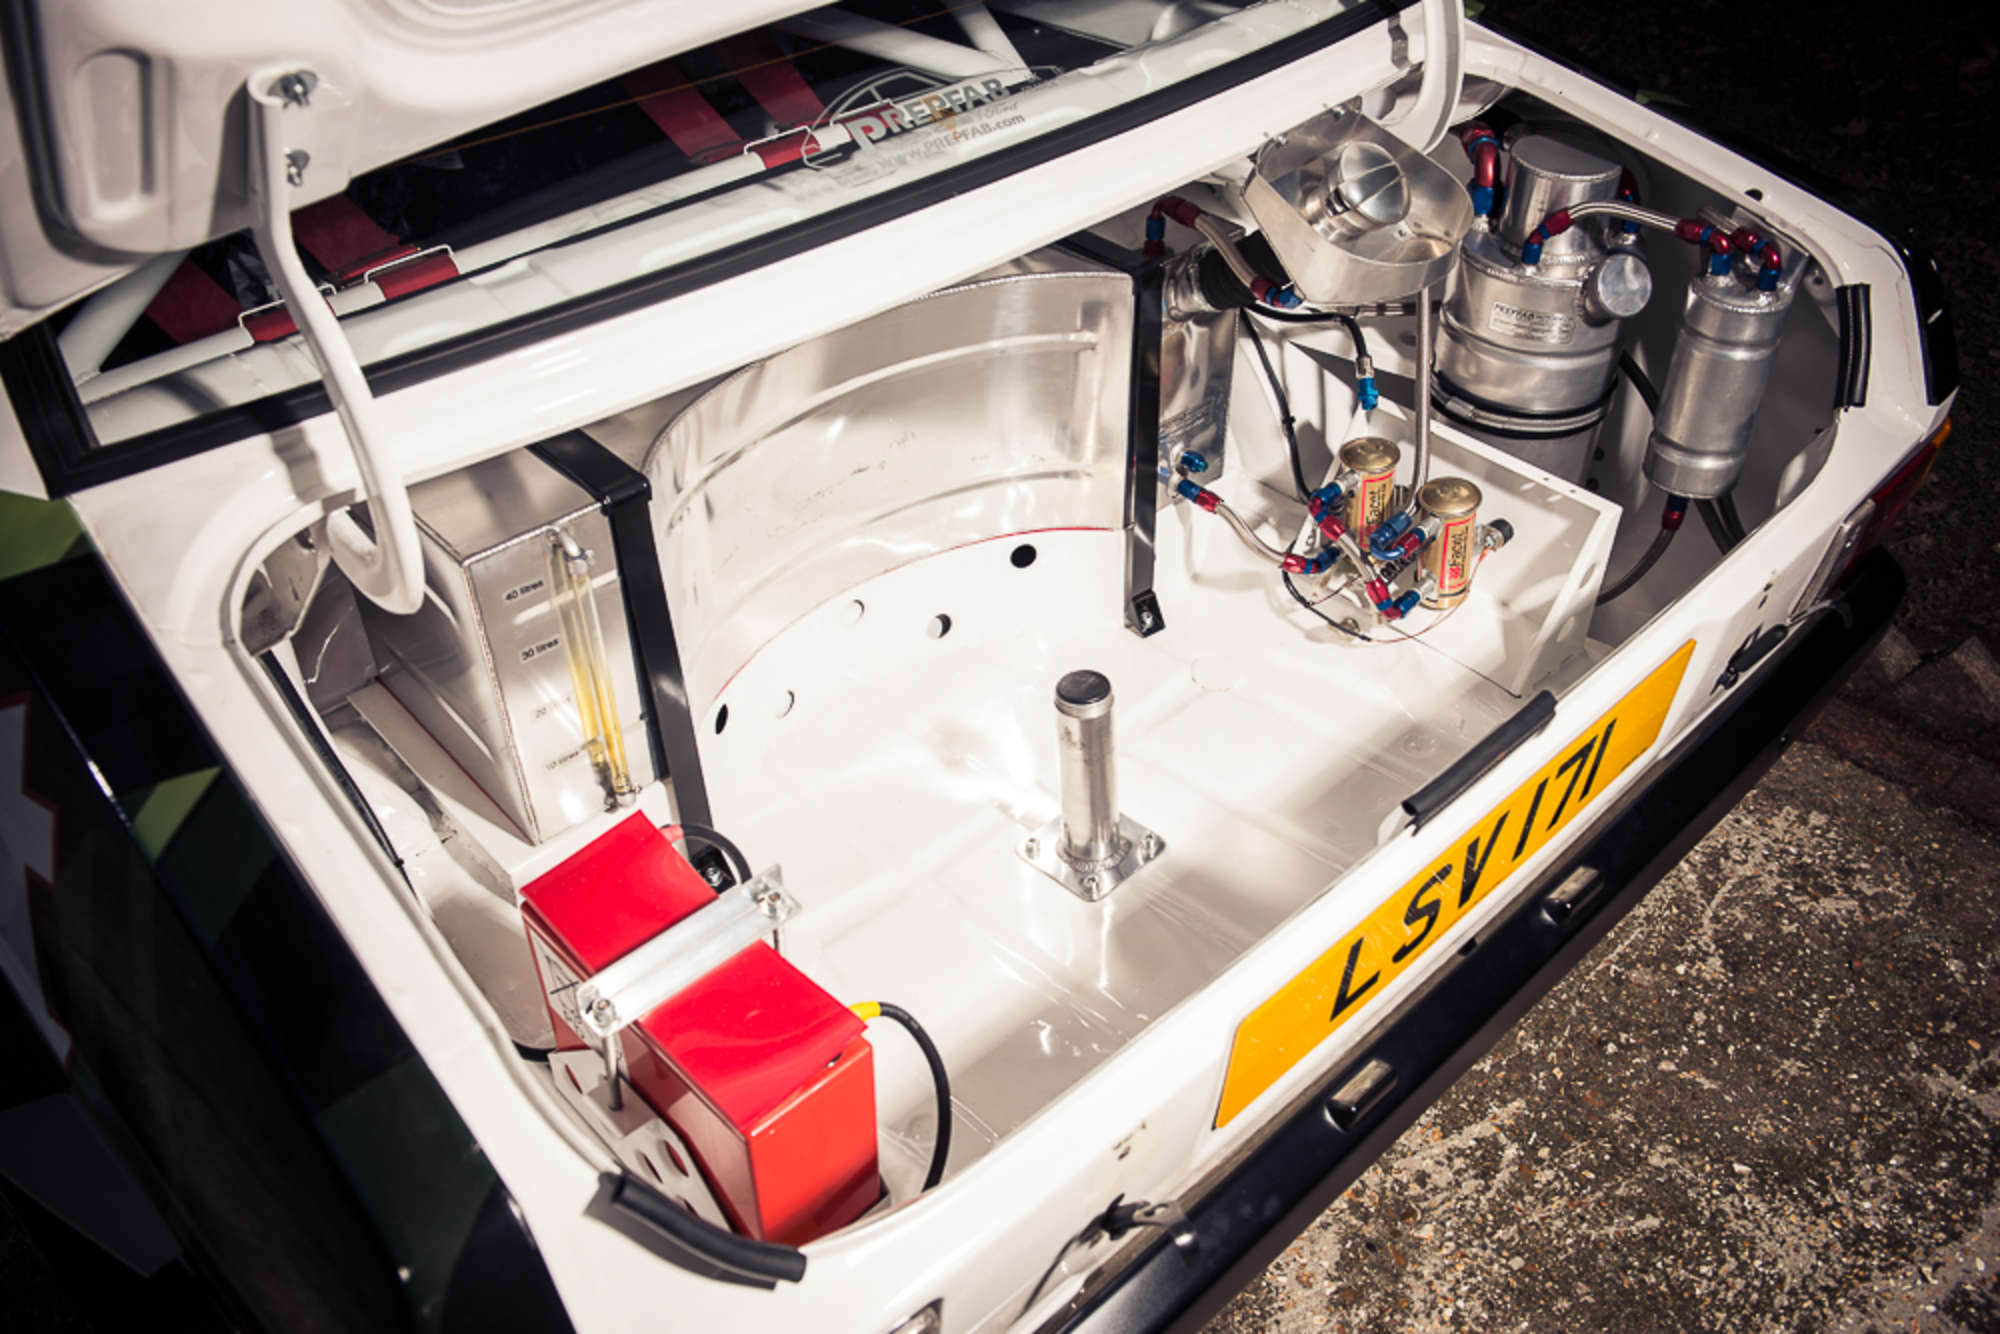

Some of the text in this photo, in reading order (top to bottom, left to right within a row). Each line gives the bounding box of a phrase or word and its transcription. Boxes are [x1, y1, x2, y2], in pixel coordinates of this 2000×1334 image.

[845, 78, 1011, 151] PREPFAB
[505, 589, 519, 601] 40
[521, 648, 535, 661] 30
[1330, 717, 1618, 1023] LSV 171
